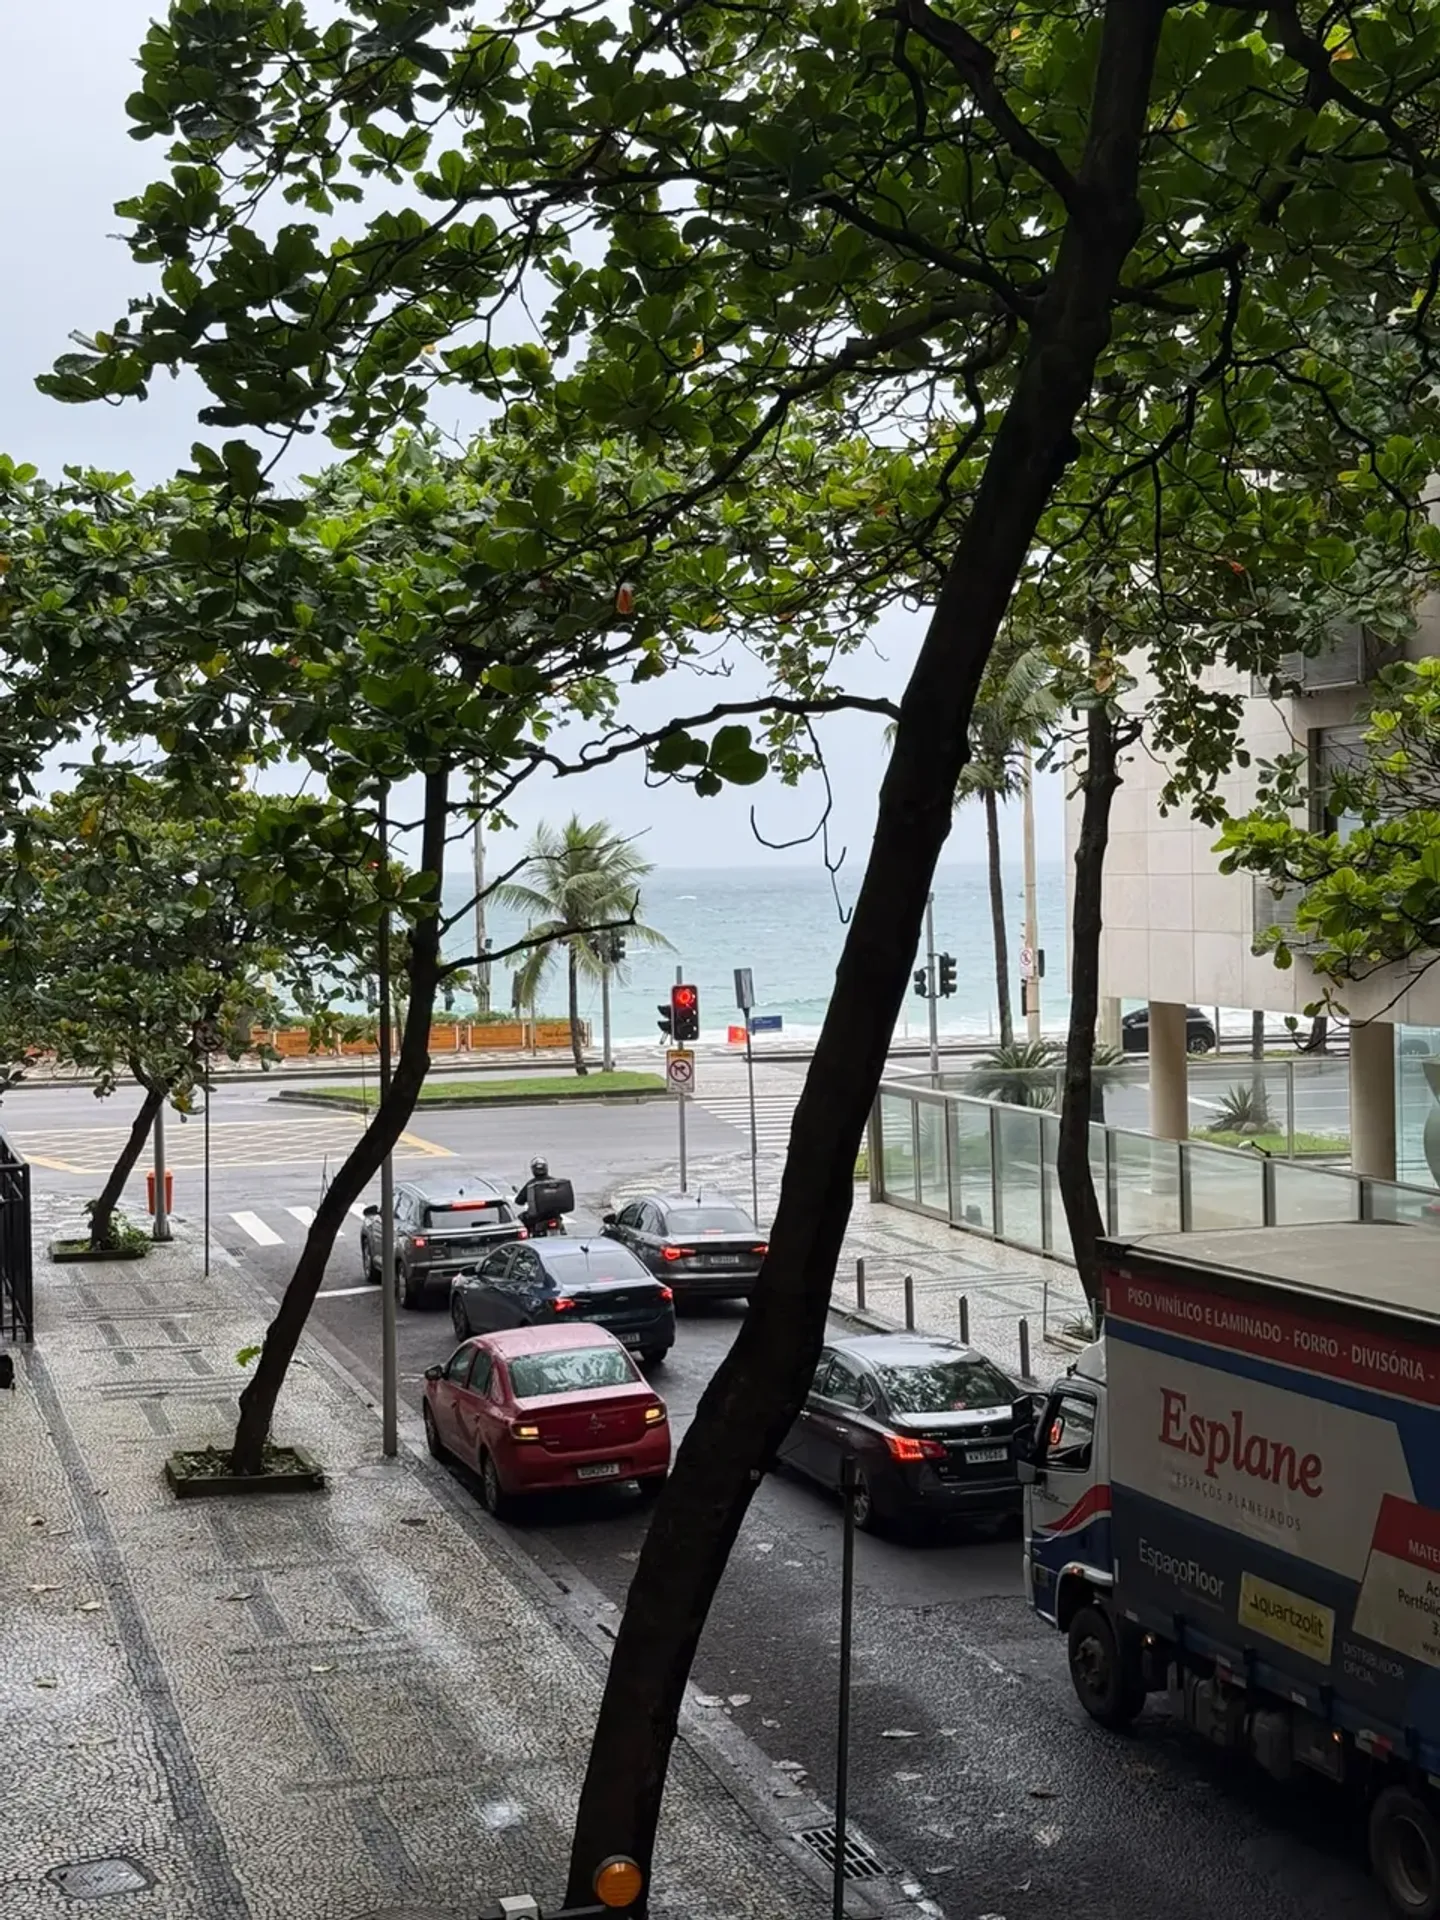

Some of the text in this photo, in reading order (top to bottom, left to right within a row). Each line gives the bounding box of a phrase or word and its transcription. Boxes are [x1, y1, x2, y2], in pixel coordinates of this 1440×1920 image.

[1128, 1287, 1151, 1308] PISO
[1154, 1293, 1202, 1322] VINÍLICO
[1205, 1308, 1213, 1325] E
[1214, 1310, 1282, 1343] LAMINADO
[1293, 1330, 1338, 1358] FORRO
[1351, 1344, 1425, 1382] DIVISÓRIA
[1158, 1386, 1324, 1498] Esplane
[1176, 1471, 1302, 1532] ESPAÇOS PLANEJADOS
[1408, 1539, 1440, 1563] MATE
